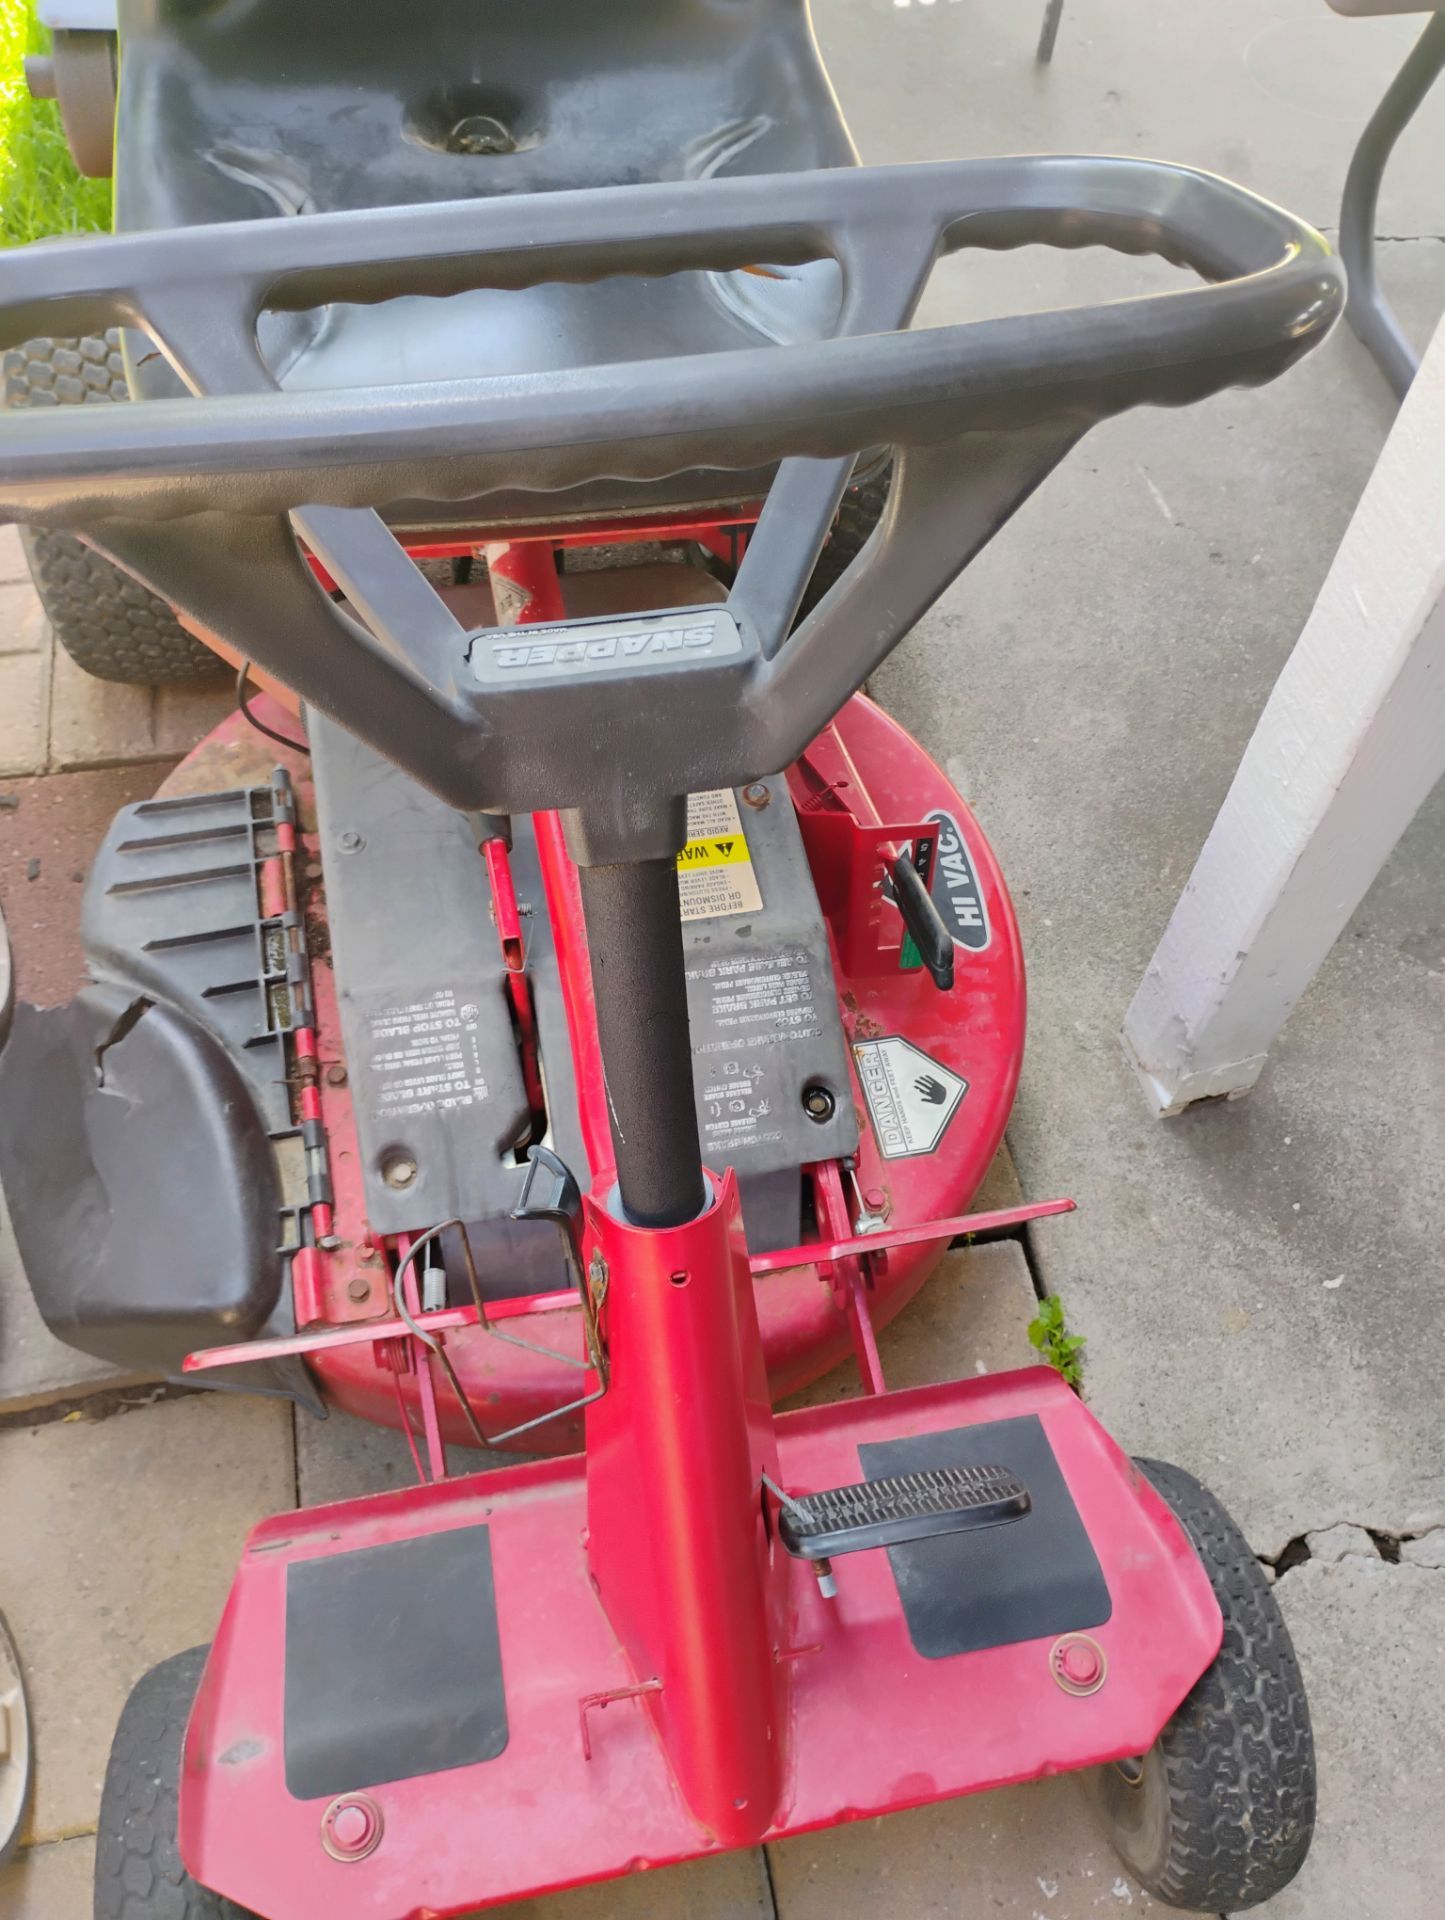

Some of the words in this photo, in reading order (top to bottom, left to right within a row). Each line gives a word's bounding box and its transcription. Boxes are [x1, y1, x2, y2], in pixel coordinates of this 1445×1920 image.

[494, 626, 714, 668] SNAPPER
[707, 827, 728, 836] AVOID
[937, 826, 970, 888] VAC.
[680, 893, 726, 906] DISMOUN
[728, 891, 741, 899] OR
[680, 906, 705, 916] STAR
[709, 901, 743, 913] BEFORE
[952, 897, 983, 926] HI
[412, 1020, 443, 1033] STOP
[446, 1018, 462, 1028] TO
[416, 1083, 453, 1097] START
[454, 1080, 471, 1090] TO
[861, 1052, 904, 1146] DANGER
[904, 1127, 914, 1144] KEEP
